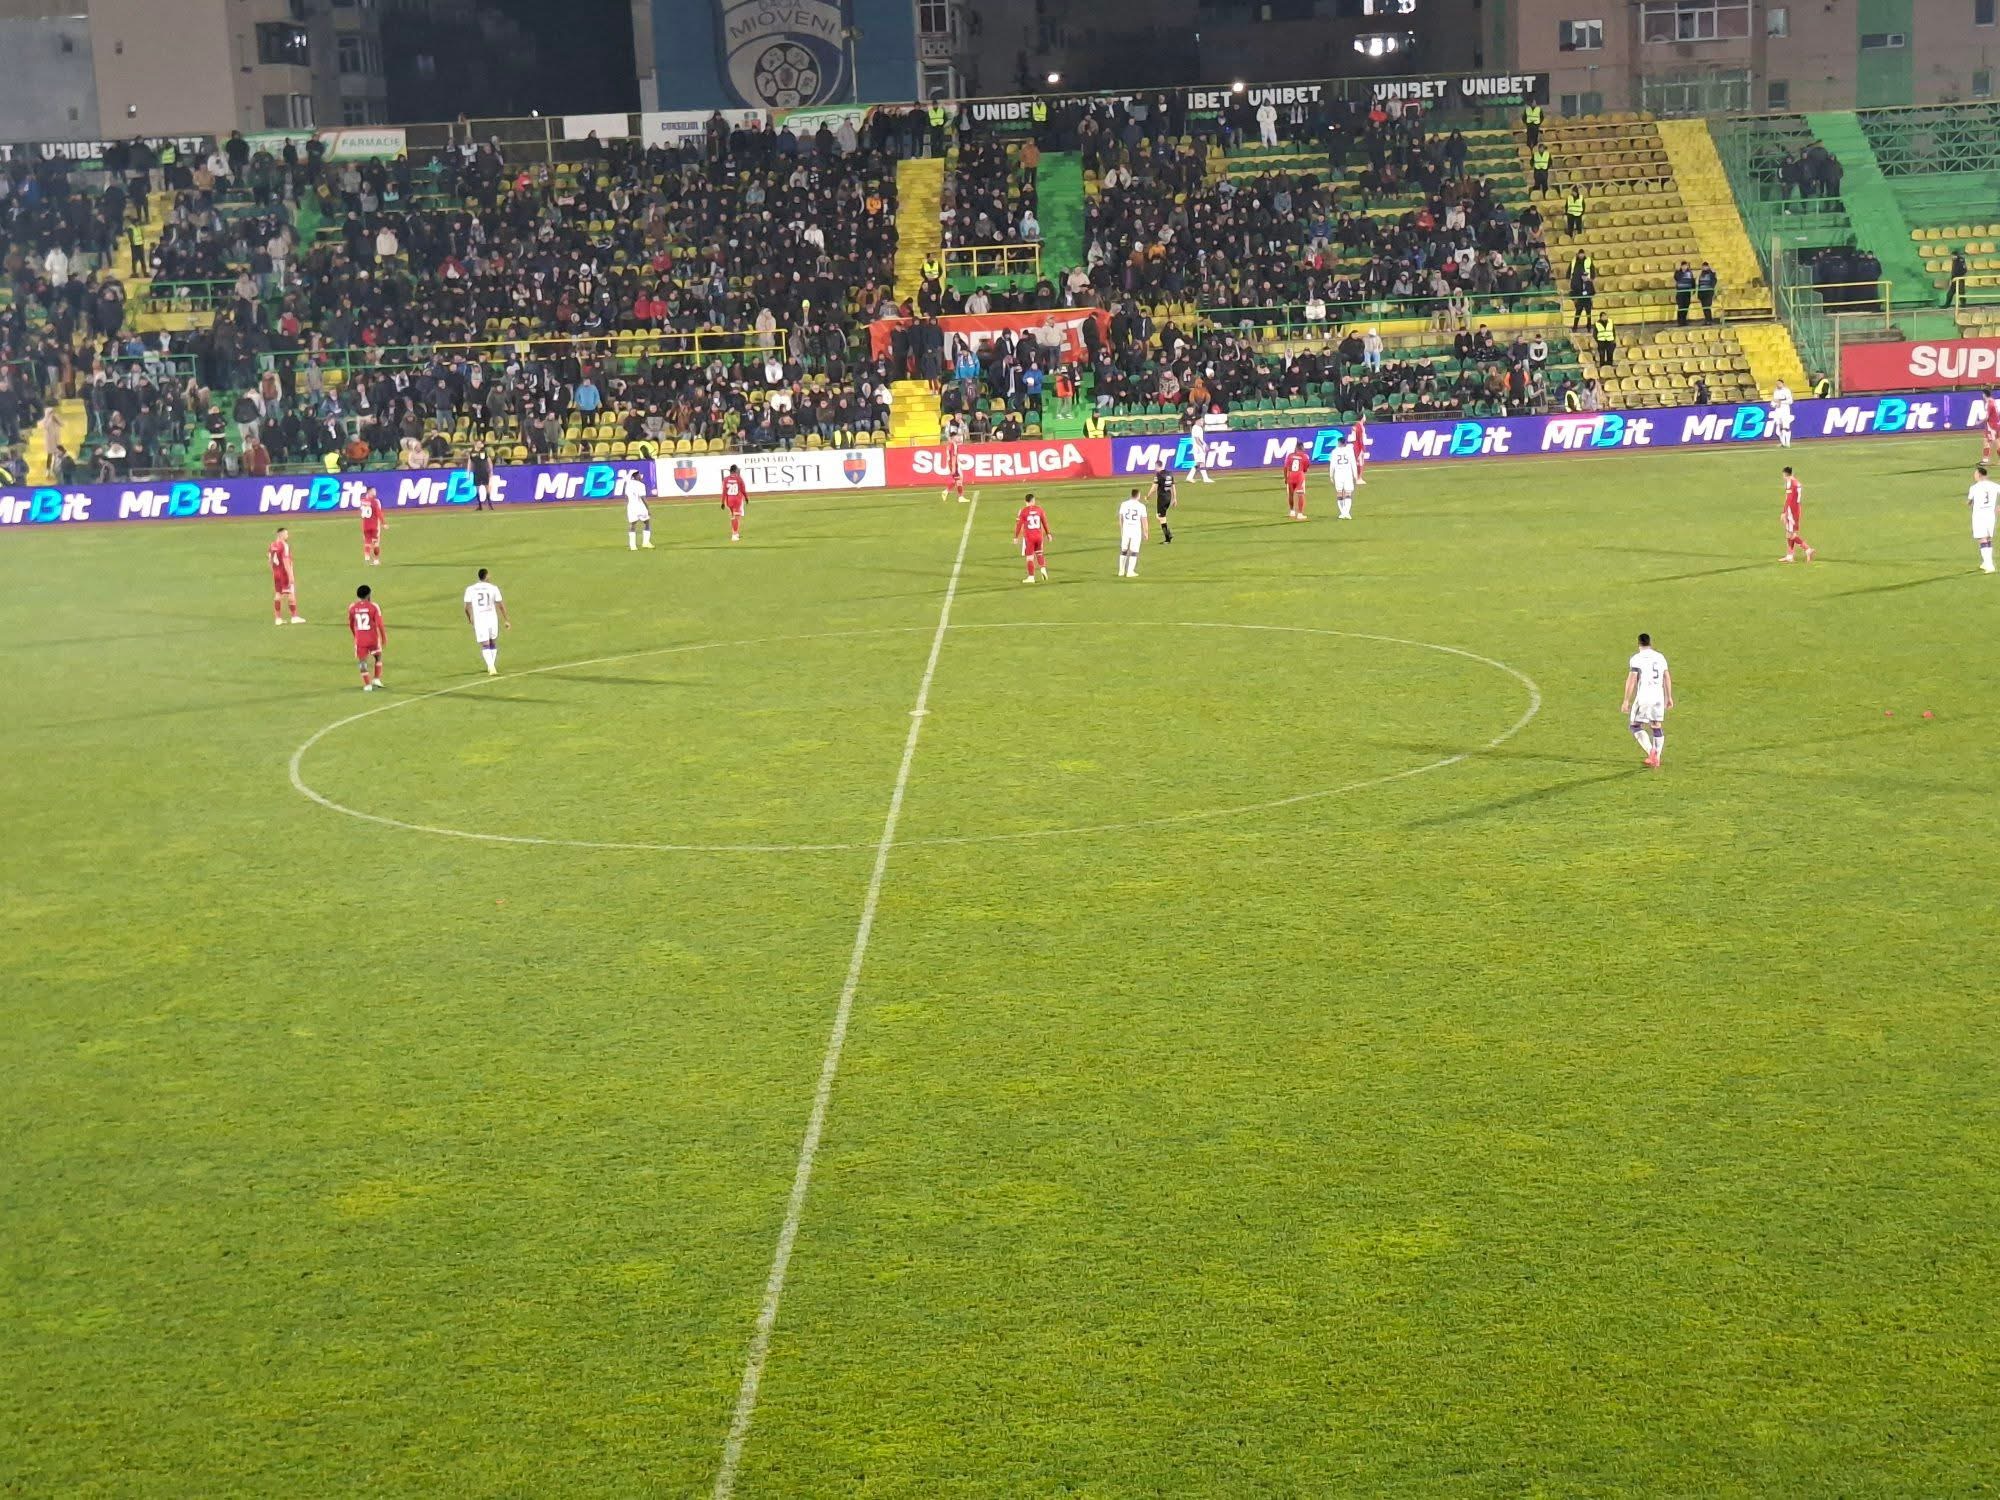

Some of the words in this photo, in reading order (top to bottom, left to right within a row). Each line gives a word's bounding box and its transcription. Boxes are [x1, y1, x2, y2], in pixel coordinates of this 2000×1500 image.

[729, 10, 836, 39] MIOVENI
[1247, 86, 1322, 106] UNIBET
[1462, 76, 1536, 96] UNIBET
[972, 101, 1033, 121] UNIBE
[1908, 345, 2000, 379] SUP
[1822, 397, 1938, 434] MrBit
[1400, 422, 1512, 458] MrBit
[1541, 414, 1654, 450] MrBit
[912, 443, 1084, 477] SUPERLIGA
[1337, 454, 1349, 465] 25
[118, 481, 231, 518] MrBit
[259, 476, 367, 512] MrBit
[477, 592, 490, 606] 21
[355, 612, 371, 631] 12
[1652, 661, 1660, 679] 5
